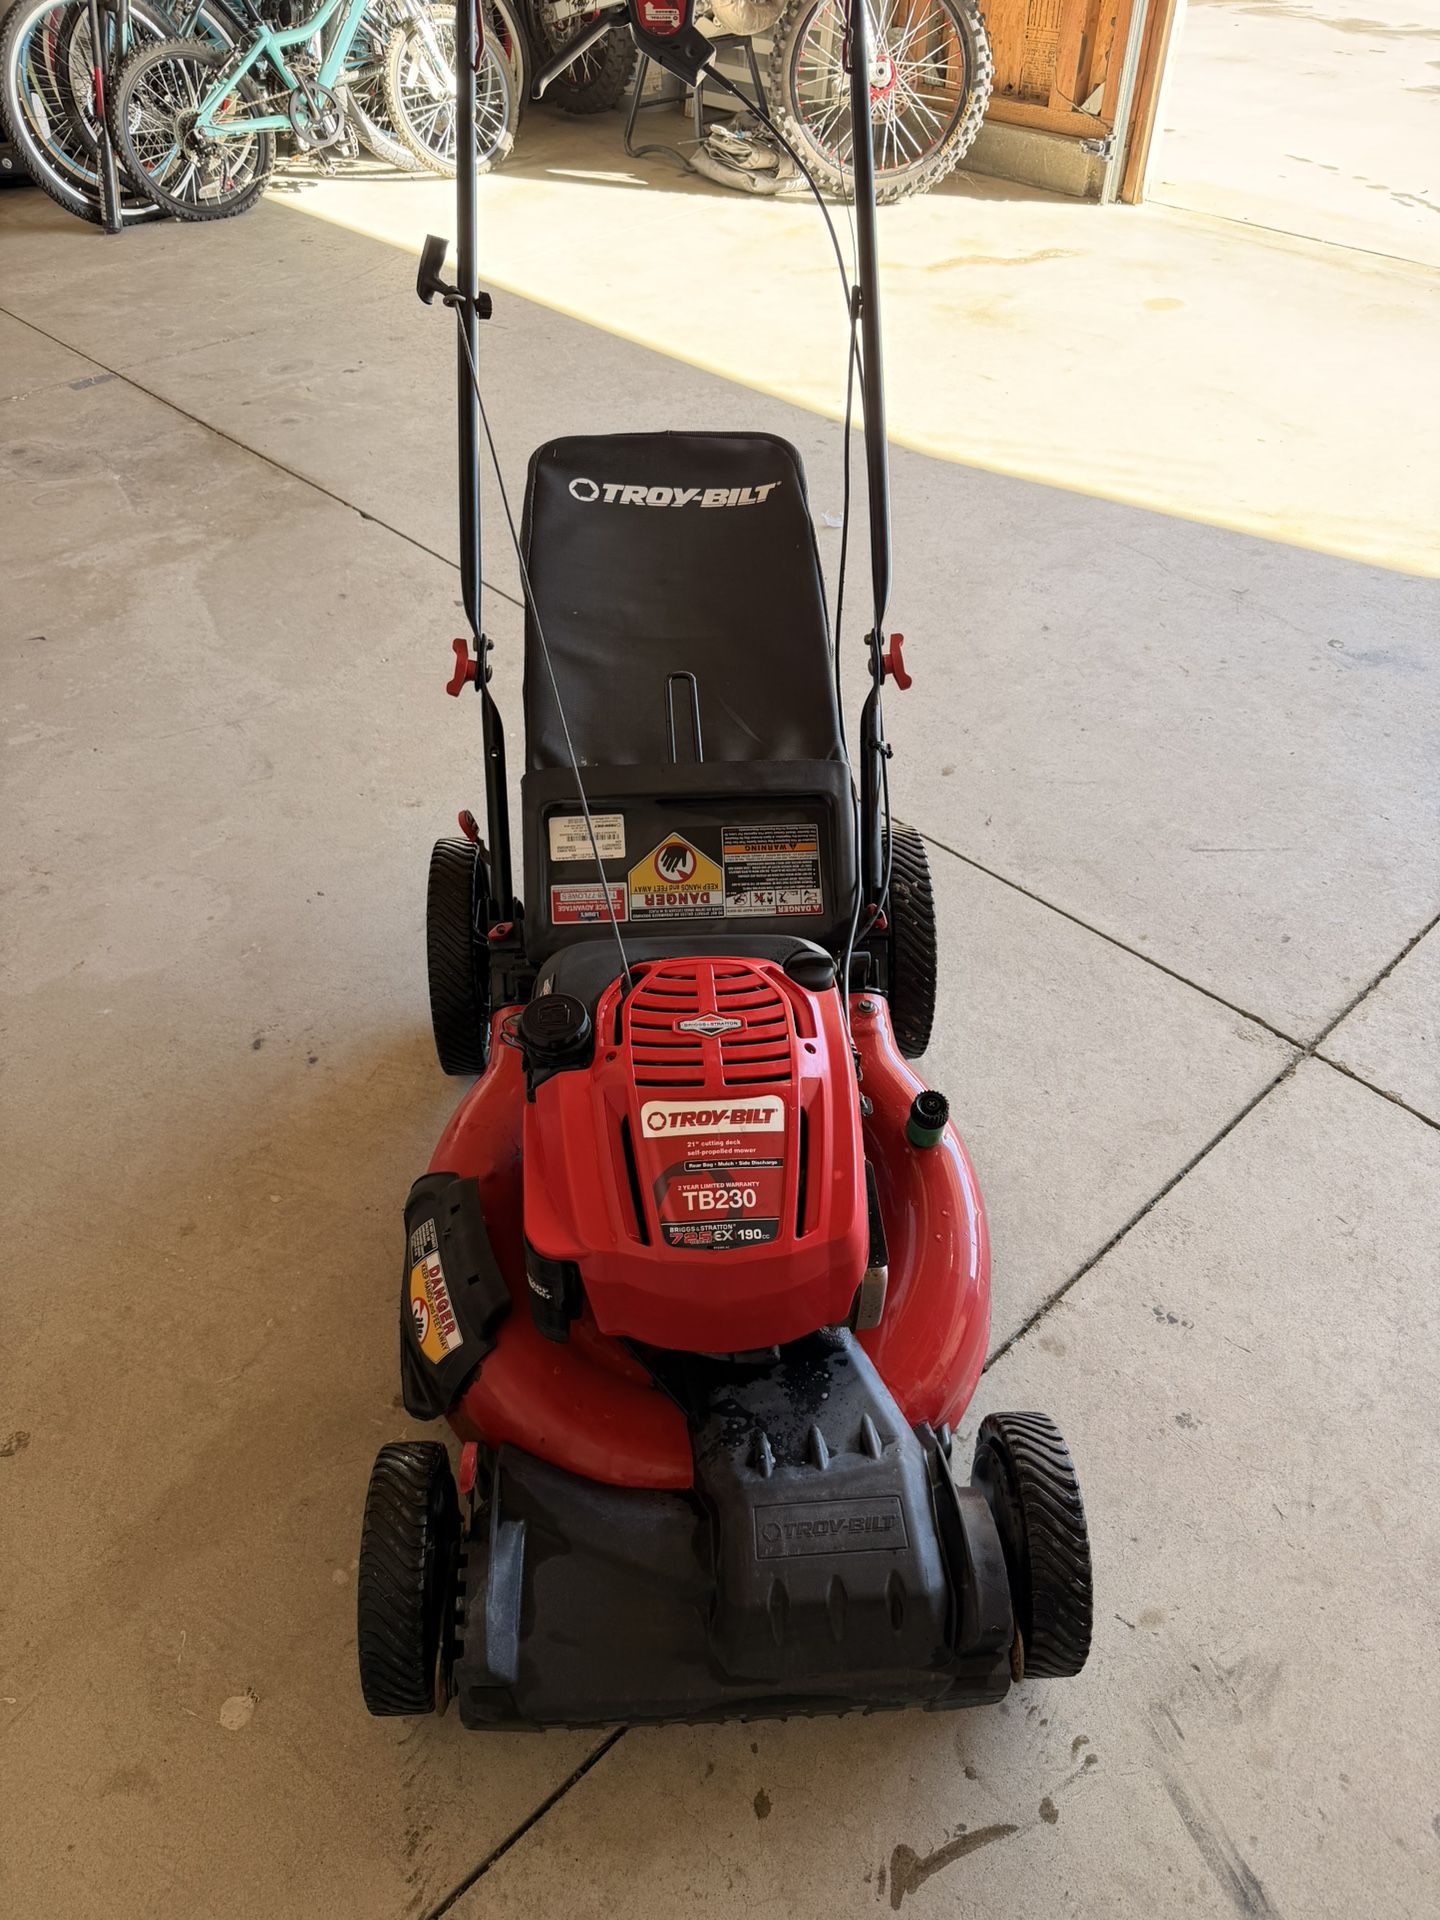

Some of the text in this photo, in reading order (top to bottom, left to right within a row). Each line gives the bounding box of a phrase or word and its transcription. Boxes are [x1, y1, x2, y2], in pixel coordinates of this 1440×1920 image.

[602, 483, 775, 508] TROY-BILT
[634, 885, 652, 893] AWAY
[681, 883, 702, 891] HANDS
[644, 892, 710, 906] DANGER
[558, 903, 621, 912] SEVICE ADVANTAGE
[778, 905, 813, 913] DANGER
[668, 1108, 775, 1128] TROY-BILT
[701, 1139, 724, 1147] cutting
[687, 1147, 732, 1156] self-propelled
[700, 1182, 725, 1190] LIMITED
[682, 1189, 757, 1211] TB230
[429, 1264, 456, 1336] DANGER
[424, 1280, 434, 1300] HANDS
[431, 1313, 442, 1331] FEET
[437, 1331, 449, 1351] AWAY
[784, 1514, 895, 1539] TROY-BILT
